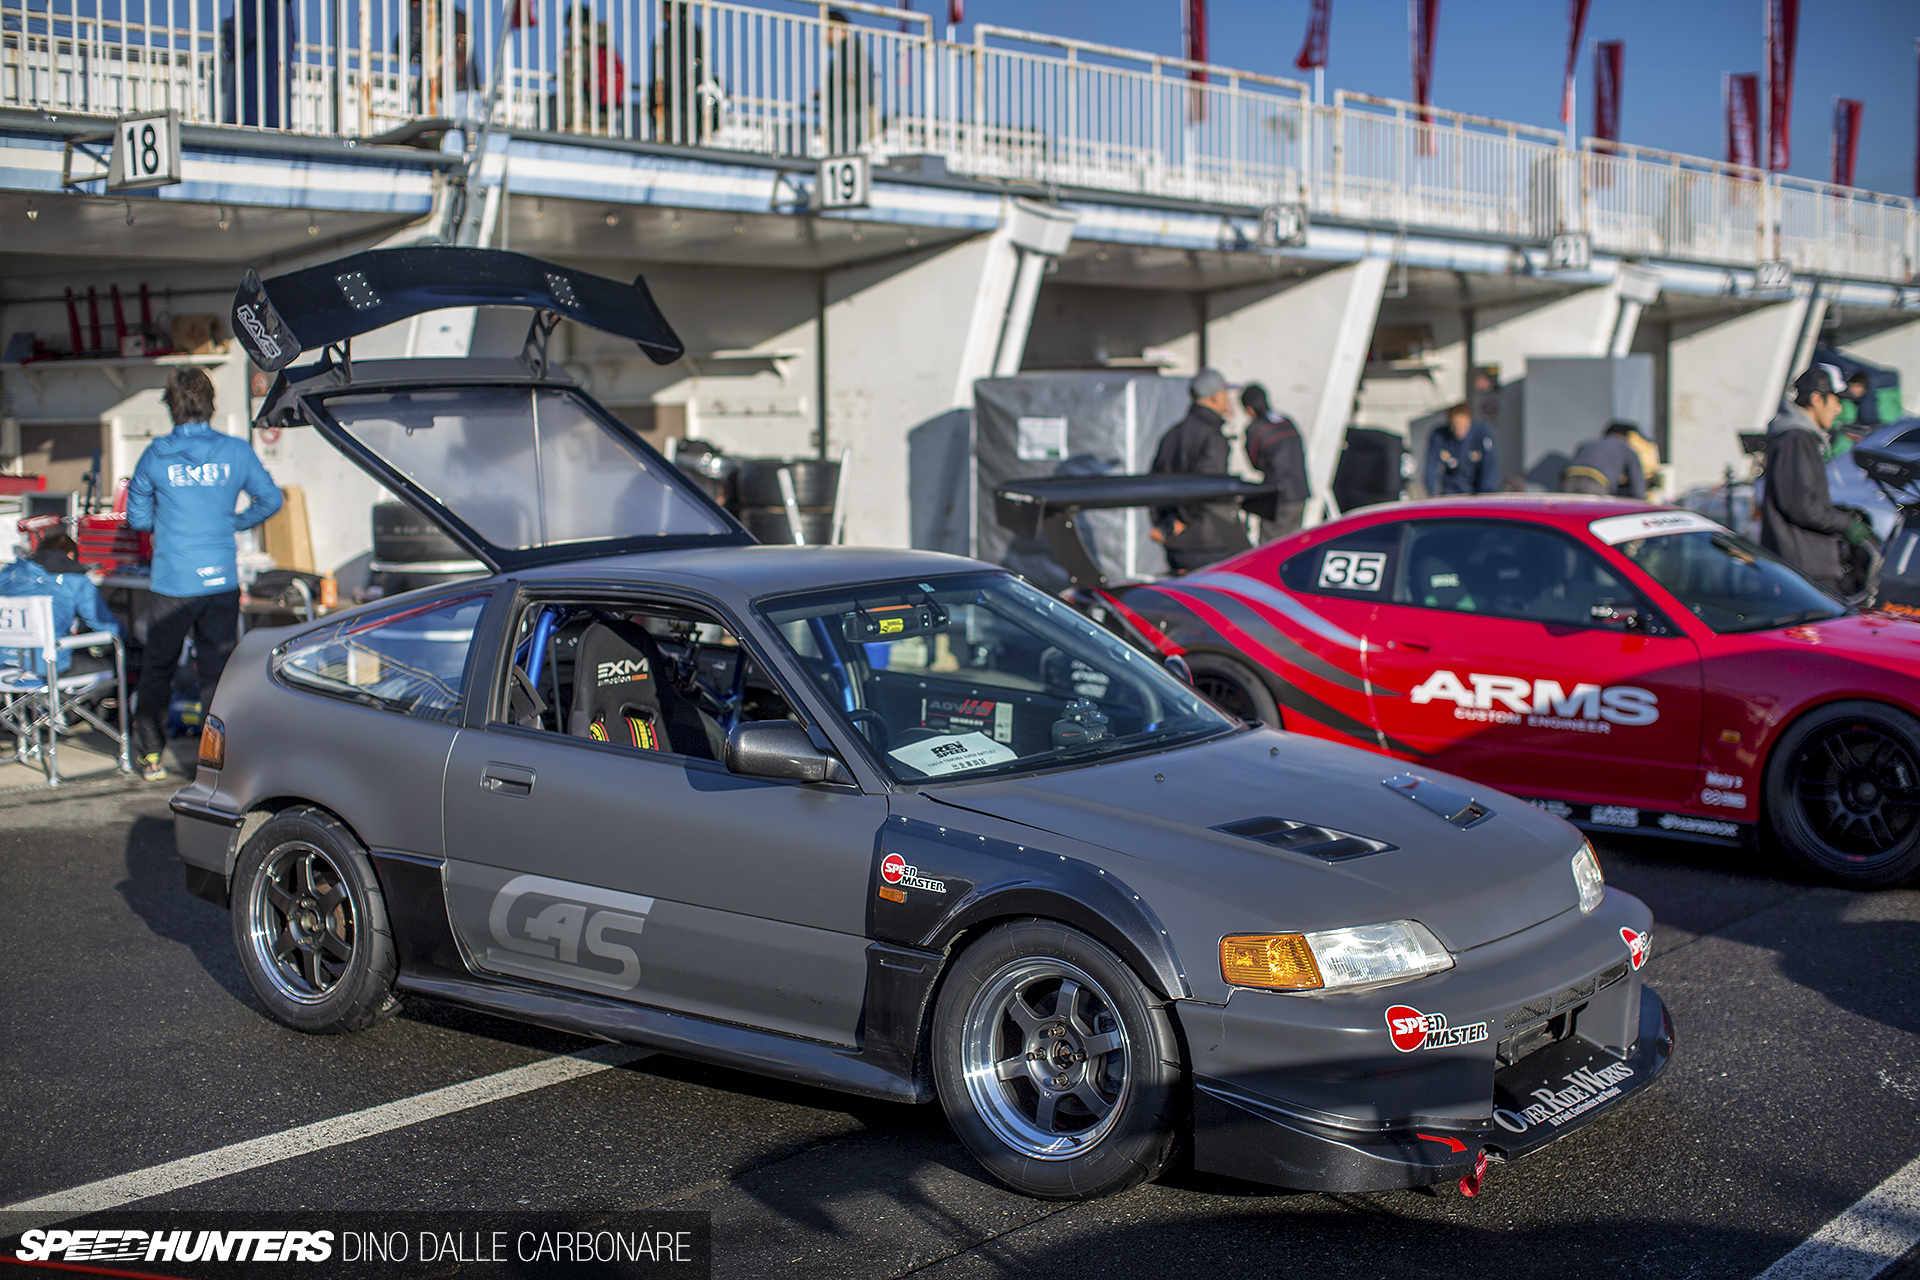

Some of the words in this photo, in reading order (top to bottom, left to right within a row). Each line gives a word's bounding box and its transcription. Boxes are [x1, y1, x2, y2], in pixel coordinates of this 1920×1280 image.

[127, 123, 158, 176] 18
[829, 163, 855, 200] 19
[237, 304, 281, 359] RAYS
[1325, 556, 1380, 585] 35
[598, 658, 649, 679] EXM
[929, 700, 989, 714] ADVAN
[1410, 670, 1659, 726] ARMS
[1454, 706, 1522, 726] CUSTOM
[1527, 714, 1612, 734] ENGINEER
[930, 741, 965, 755] REV
[936, 748, 969, 759] SPEED
[885, 863, 917, 877] SPEED
[901, 876, 943, 891] MASTER
[1392, 1015, 1445, 1035] SPEED
[1426, 1024, 1486, 1048] MASTER
